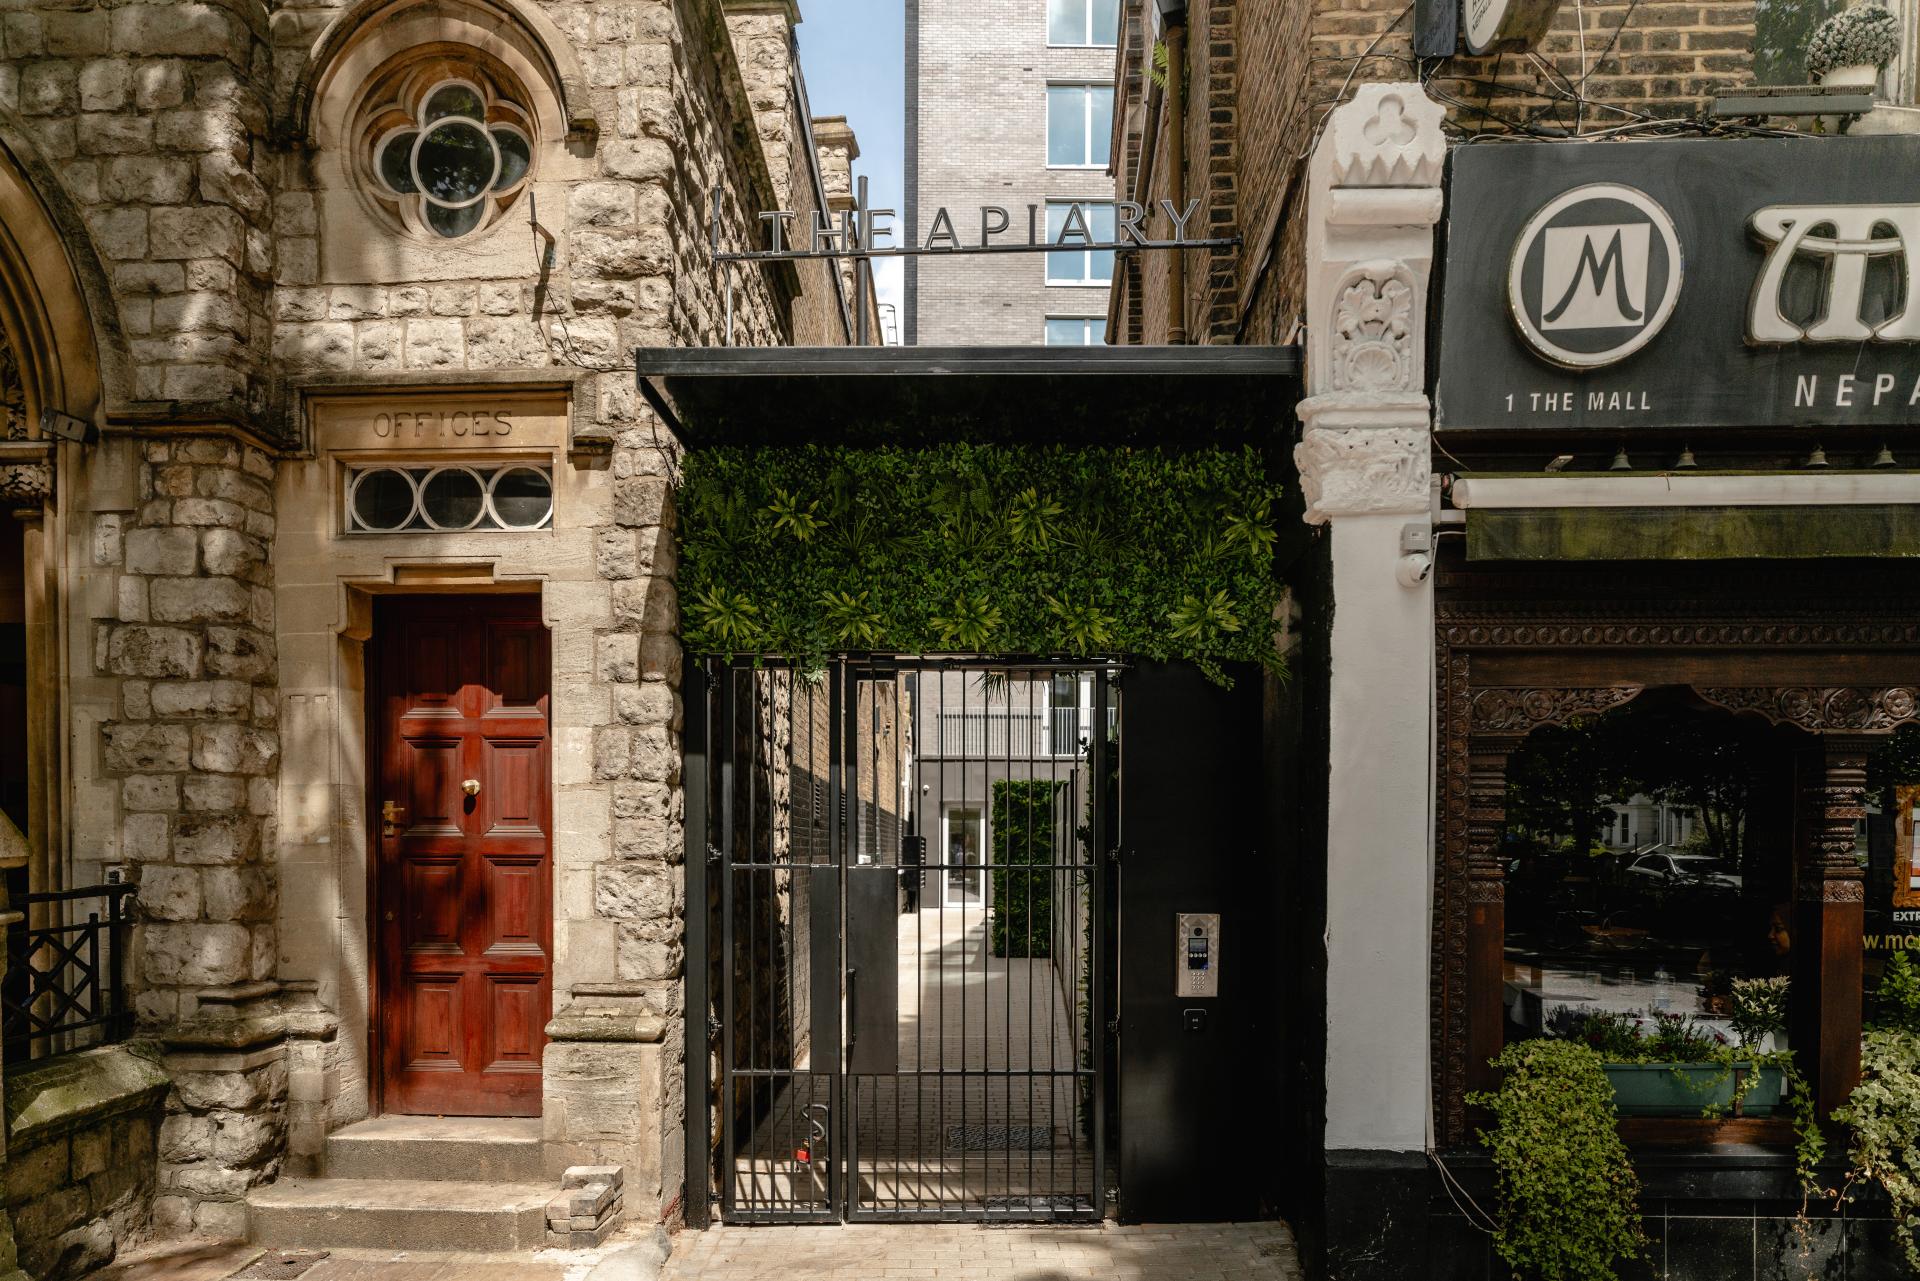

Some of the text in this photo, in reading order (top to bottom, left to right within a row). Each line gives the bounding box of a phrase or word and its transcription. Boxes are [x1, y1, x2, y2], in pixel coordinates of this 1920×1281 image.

[758, 199, 1200, 255] THE APIARY
[1543, 228, 1642, 322] M
[1505, 391, 1652, 412] 1 THE MALL
[372, 410, 513, 438] OFFICES
